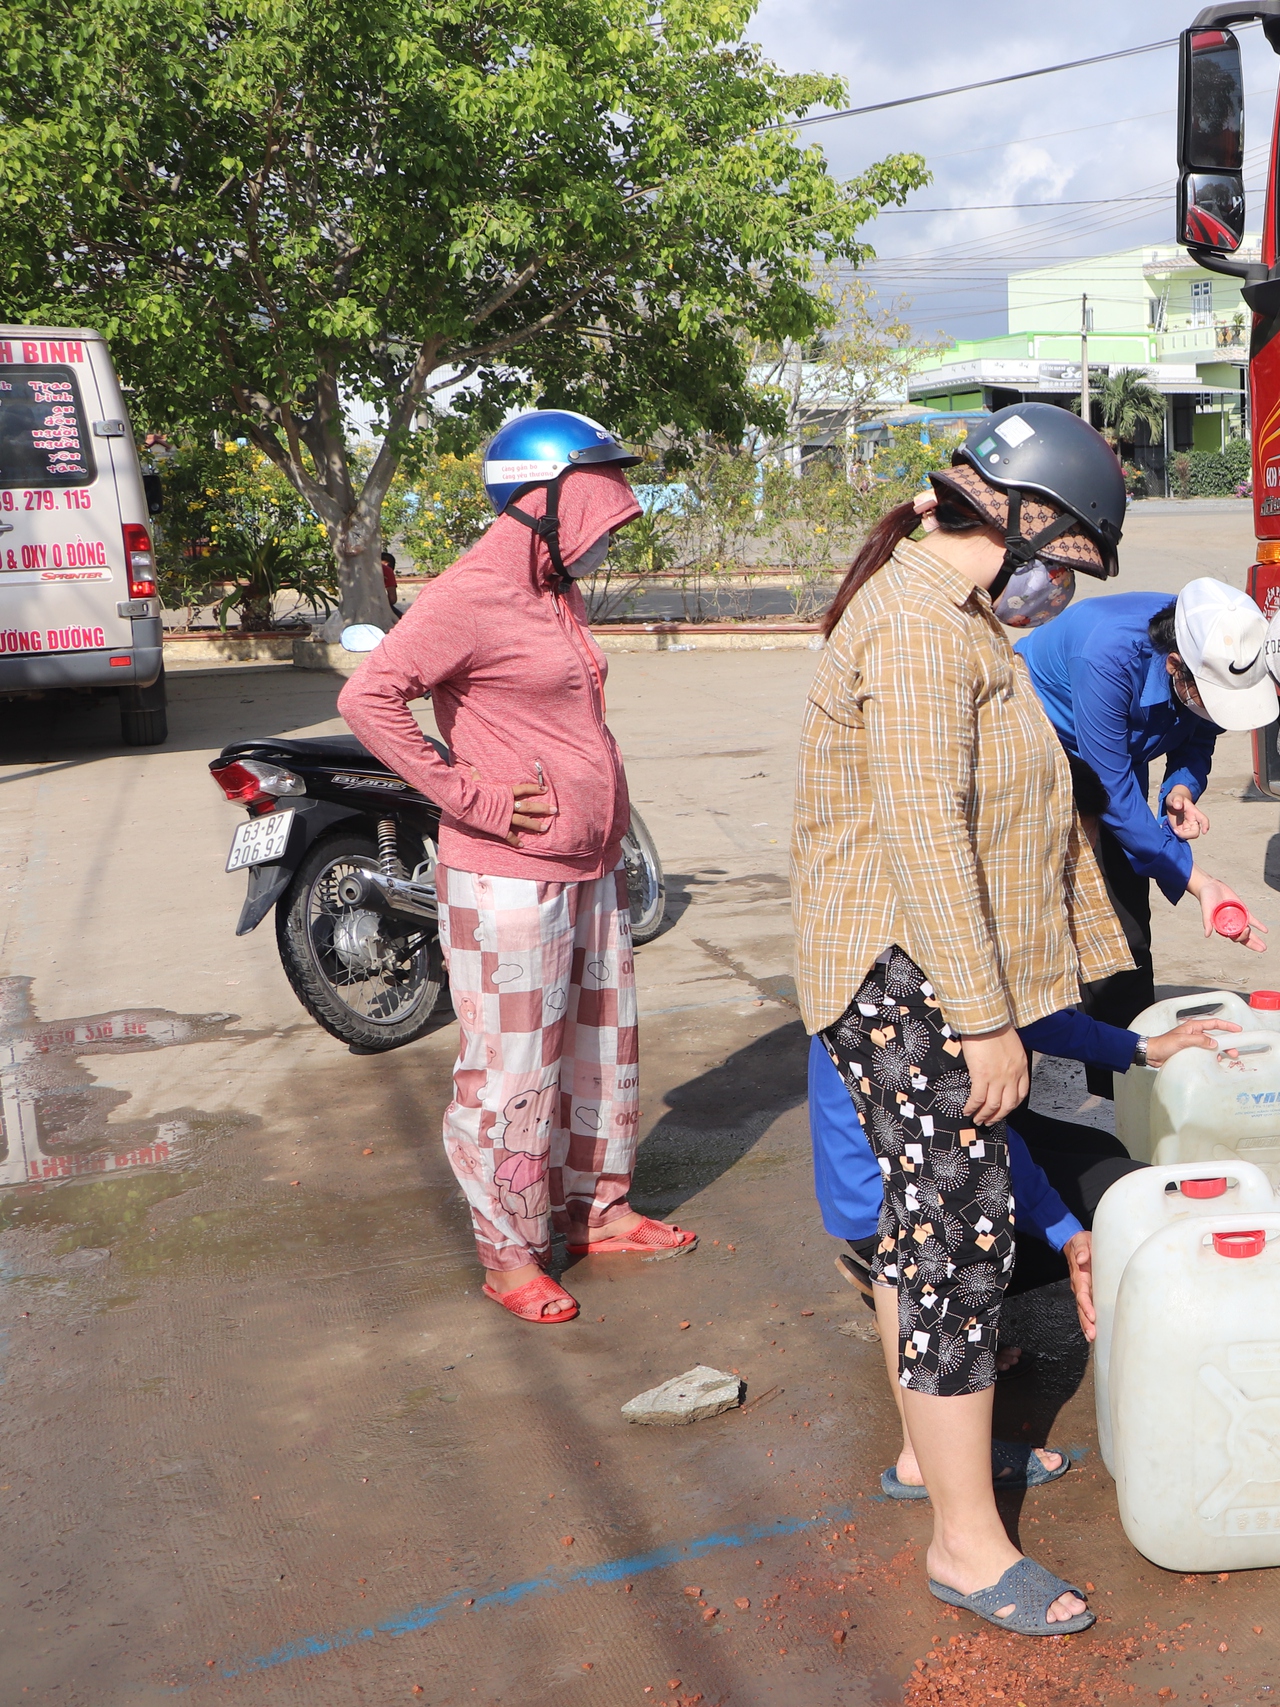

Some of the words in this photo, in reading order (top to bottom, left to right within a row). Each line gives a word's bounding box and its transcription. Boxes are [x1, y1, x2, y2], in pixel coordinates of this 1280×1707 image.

[22, 341, 84, 363] BINH
[28, 380, 72, 392] Trao
[62, 488, 92, 510] 115
[21, 544, 47, 569] OXY
[46, 625, 106, 651] ĐƯỜNG
